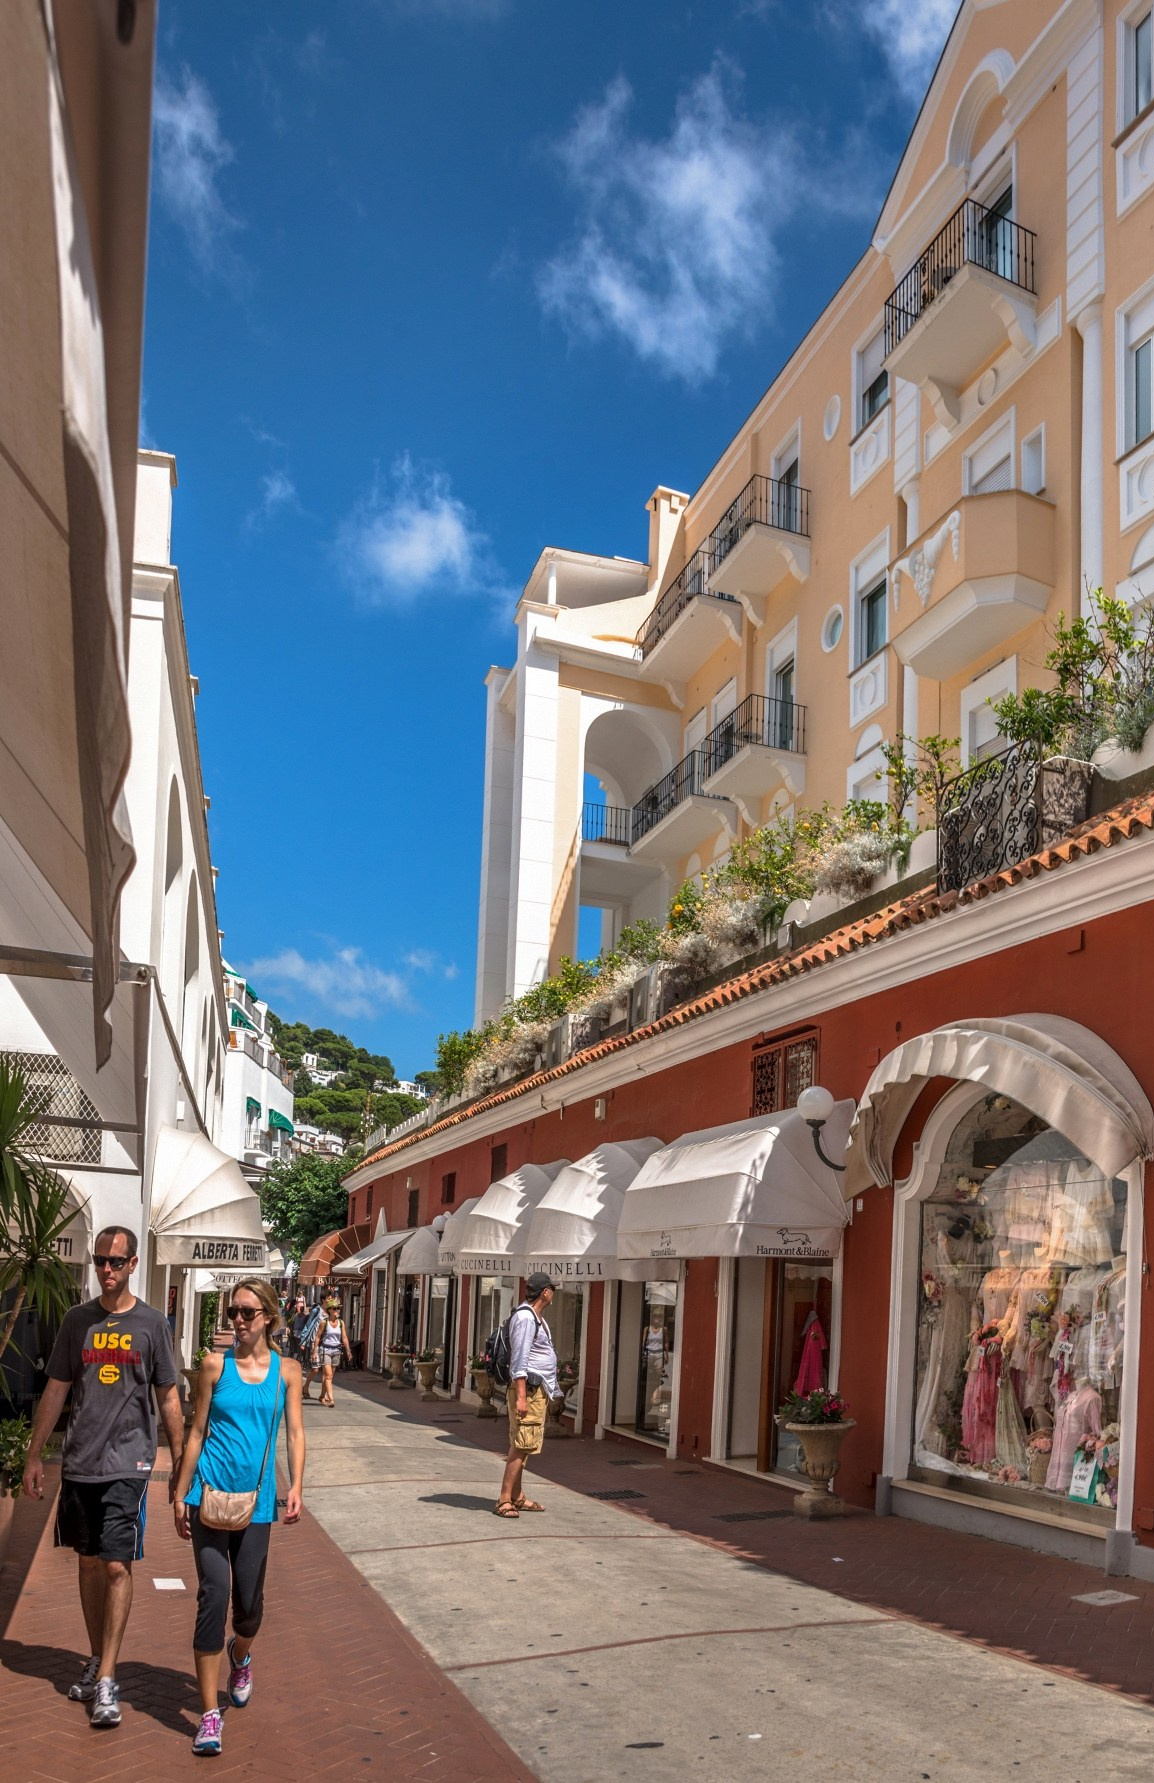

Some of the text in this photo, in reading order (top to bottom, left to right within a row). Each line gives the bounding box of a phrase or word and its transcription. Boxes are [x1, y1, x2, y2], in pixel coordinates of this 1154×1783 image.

[192, 1242, 239, 1261] ALBERTA
[461, 1259, 511, 1272] CUCINELLI
[528, 1262, 602, 1275] CUCINELLI
[318, 1277, 333, 1286] BAR
[93, 1332, 132, 1350] USC
[82, 1349, 142, 1365] BASEBALL
